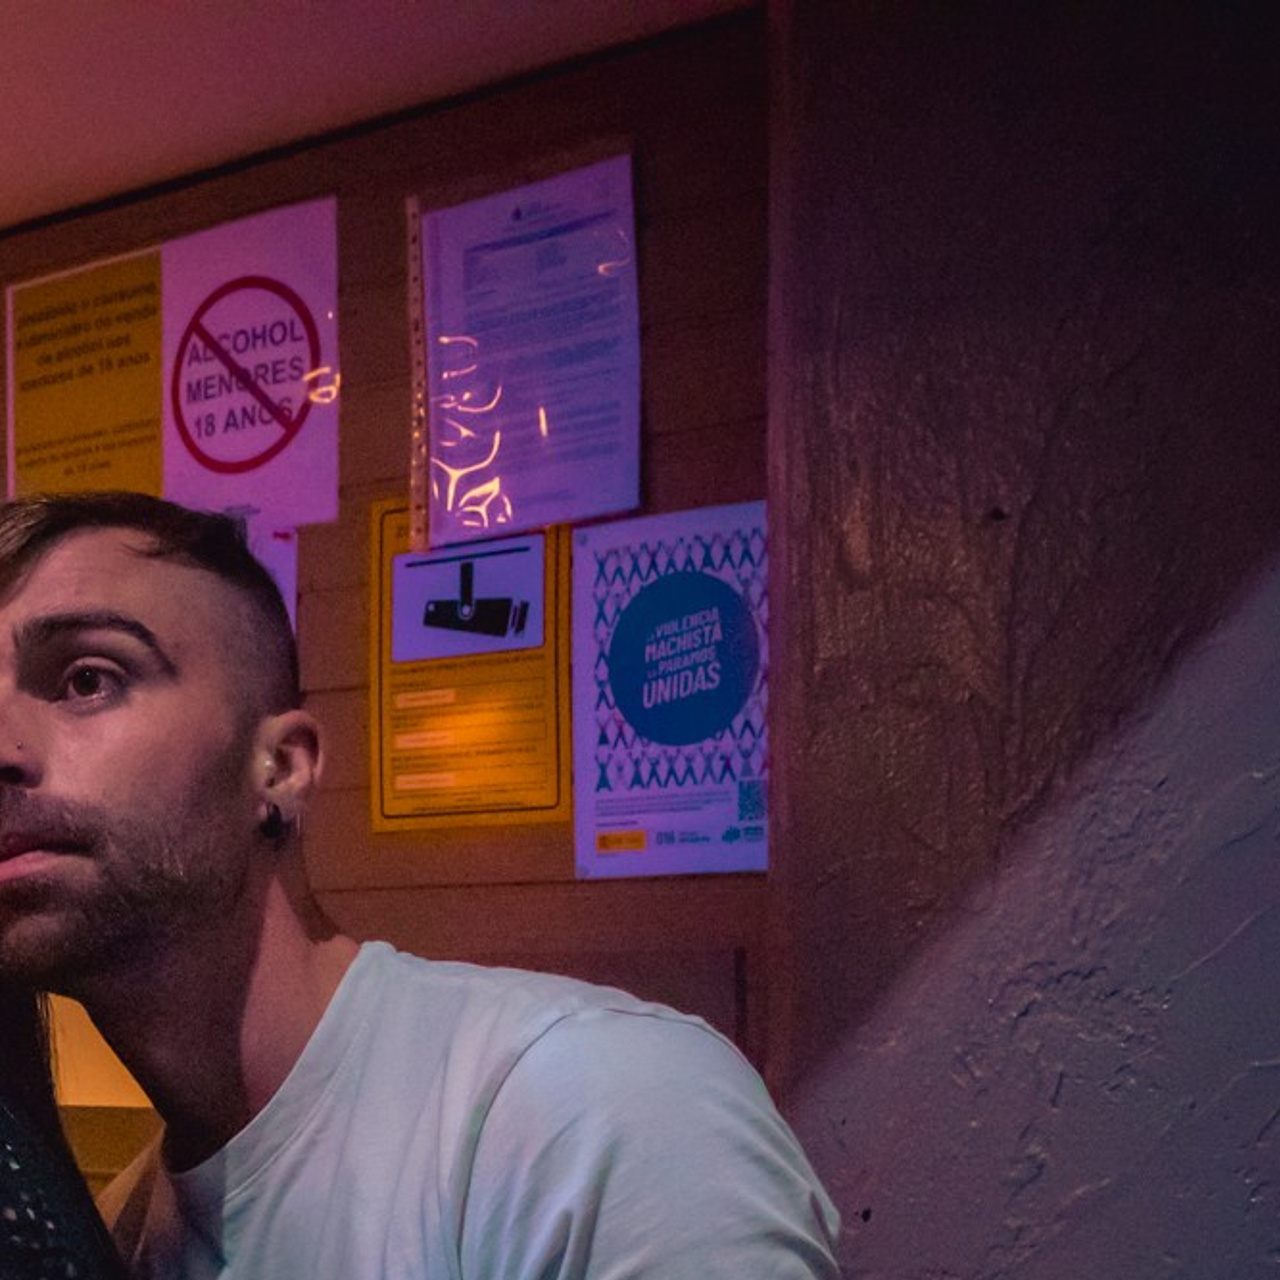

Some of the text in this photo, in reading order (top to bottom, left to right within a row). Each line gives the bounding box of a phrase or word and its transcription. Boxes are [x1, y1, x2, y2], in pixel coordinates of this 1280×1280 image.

[195, 412, 216, 439] 18
[645, 621, 723, 664] MACHISTA
[643, 660, 722, 709] UNIDAS
